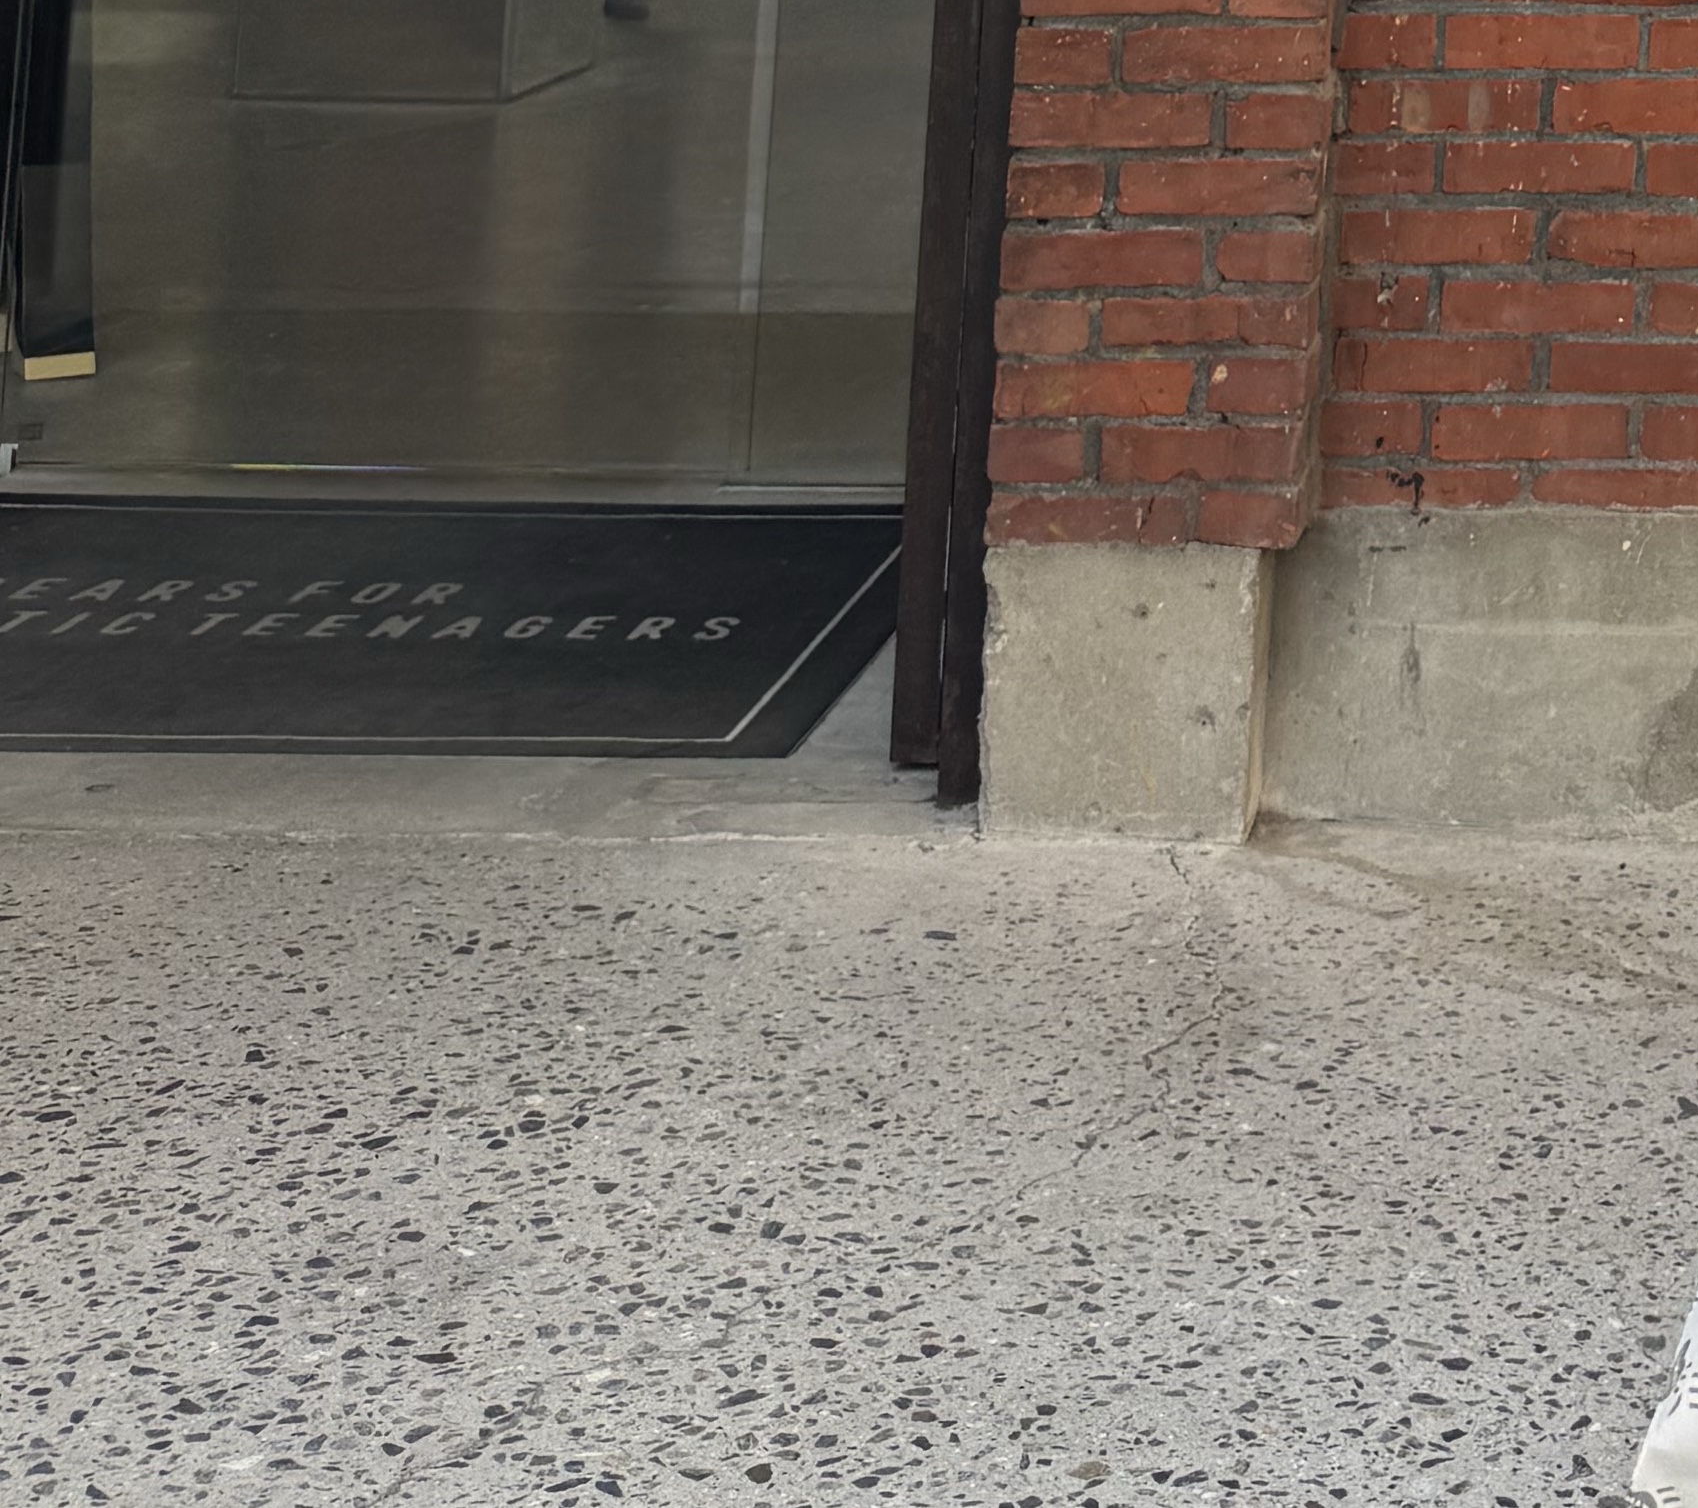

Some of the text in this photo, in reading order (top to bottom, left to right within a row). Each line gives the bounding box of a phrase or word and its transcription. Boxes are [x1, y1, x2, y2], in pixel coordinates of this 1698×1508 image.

[0, 577, 465, 605] EARS FOR
[0, 610, 741, 641] TIC TEENAGERS
